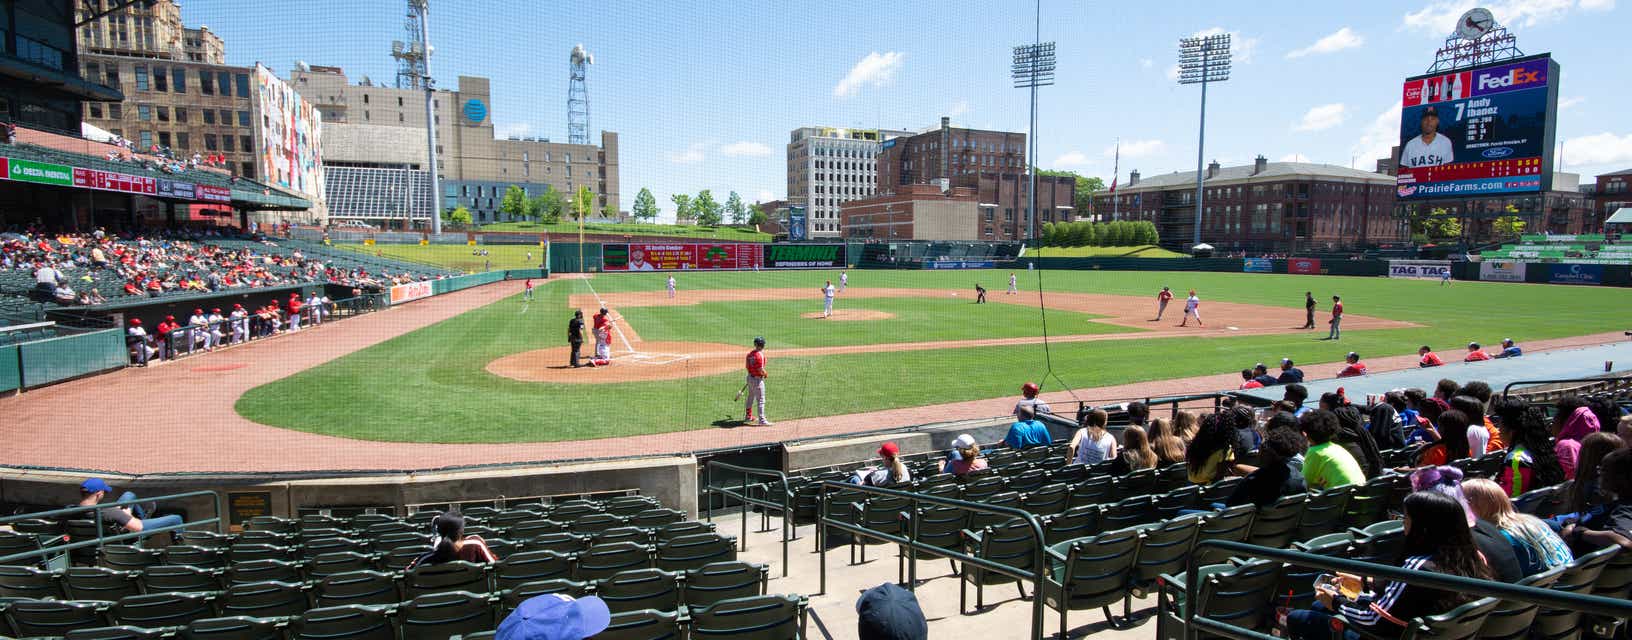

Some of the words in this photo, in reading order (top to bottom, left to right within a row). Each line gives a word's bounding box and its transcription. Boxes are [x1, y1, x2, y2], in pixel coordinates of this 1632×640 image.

[1478, 68, 1537, 90] FedEx
[1468, 98, 1491, 108] Andy
[1455, 103, 1465, 121] 7
[1410, 154, 1443, 167] NASH
[23, 167, 45, 177] DELTA
[45, 170, 70, 180] DENTAL
[1418, 181, 1502, 193] PrairieFarms.com
[769, 245, 840, 260] TERMINIX
[1391, 266, 1417, 275] TAG
